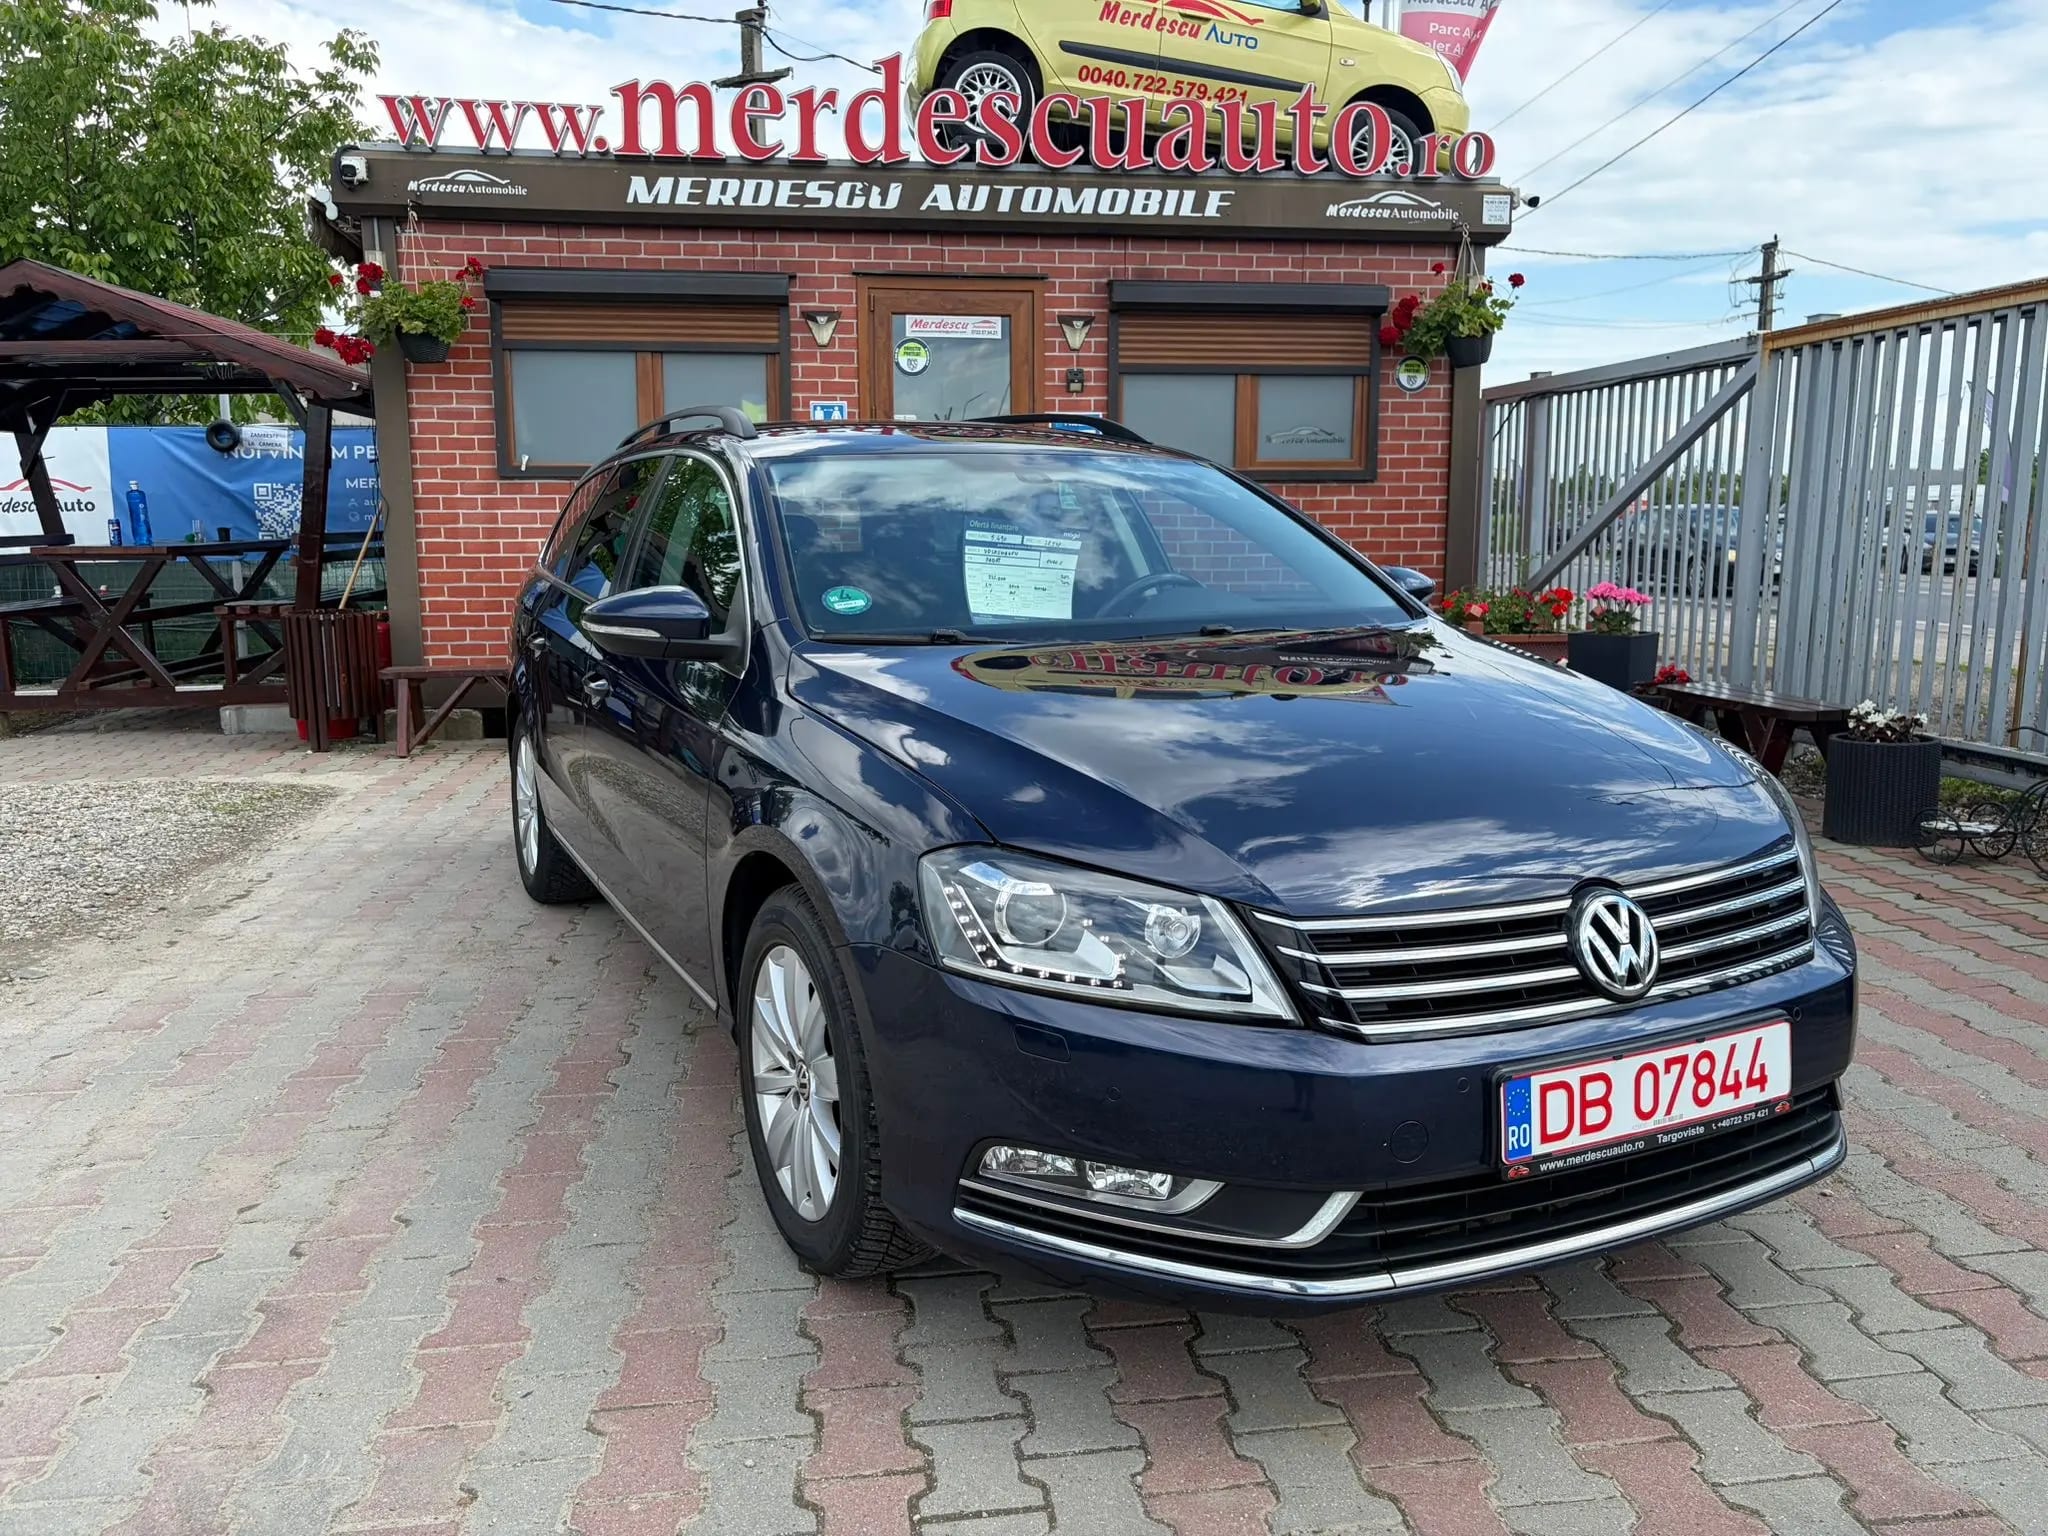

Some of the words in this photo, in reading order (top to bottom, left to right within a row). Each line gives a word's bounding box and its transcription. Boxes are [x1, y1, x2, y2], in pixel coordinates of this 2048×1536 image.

[1098, 1, 1202, 40] Merdescu
[1429, 22, 1461, 37] Parc
[1077, 64, 1248, 106] 0040.722.579.421
[376, 52, 1496, 179] www.merdescuauto.ro
[626, 175, 904, 210] MERDESCU
[920, 183, 1236, 218] AUTOMOBILE
[911, 318, 969, 330] Merdescu
[1539, 1071, 1613, 1145] DB
[1633, 1036, 1769, 1121] 07844
[1508, 1123, 1531, 1151] RO
[1539, 1139, 1645, 1173] www.merdescuauto.ro
[1656, 1125, 1705, 1145] Targoviste
[1743, 1111, 1756, 1122] 579
[1756, 1108, 1769, 1118] 421
